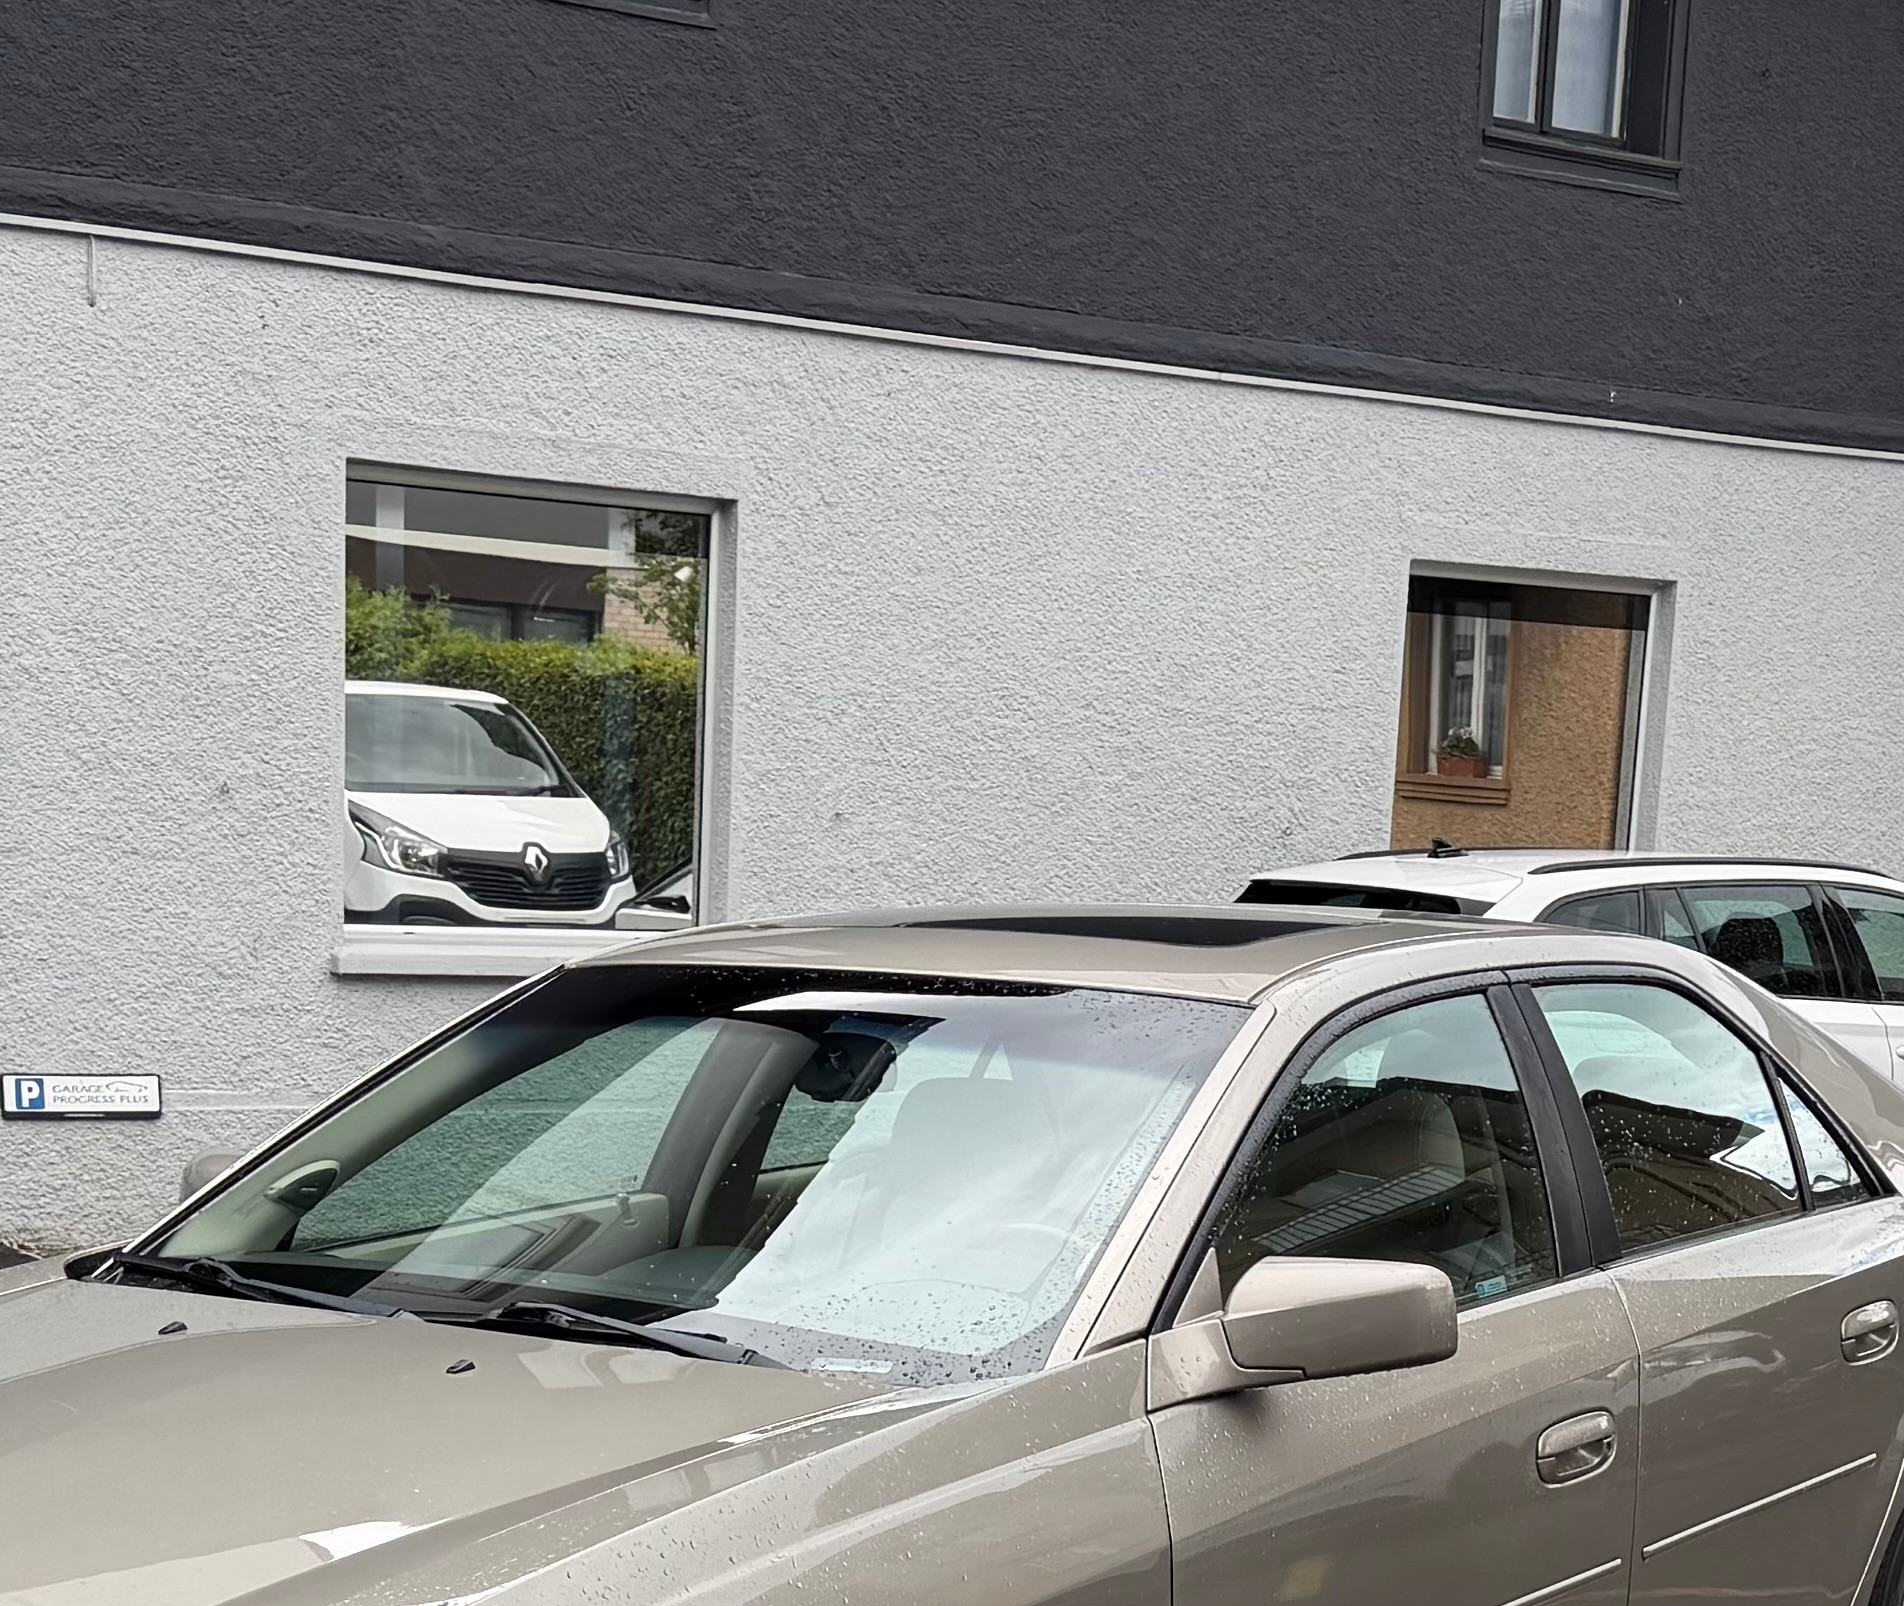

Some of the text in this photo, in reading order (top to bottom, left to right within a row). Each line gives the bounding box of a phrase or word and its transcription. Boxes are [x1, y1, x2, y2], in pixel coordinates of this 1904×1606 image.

[21, 1080, 40, 1107] P
[52, 1084, 103, 1094] GARAGE
[52, 1095, 149, 1104] PROGRESS PLUS
